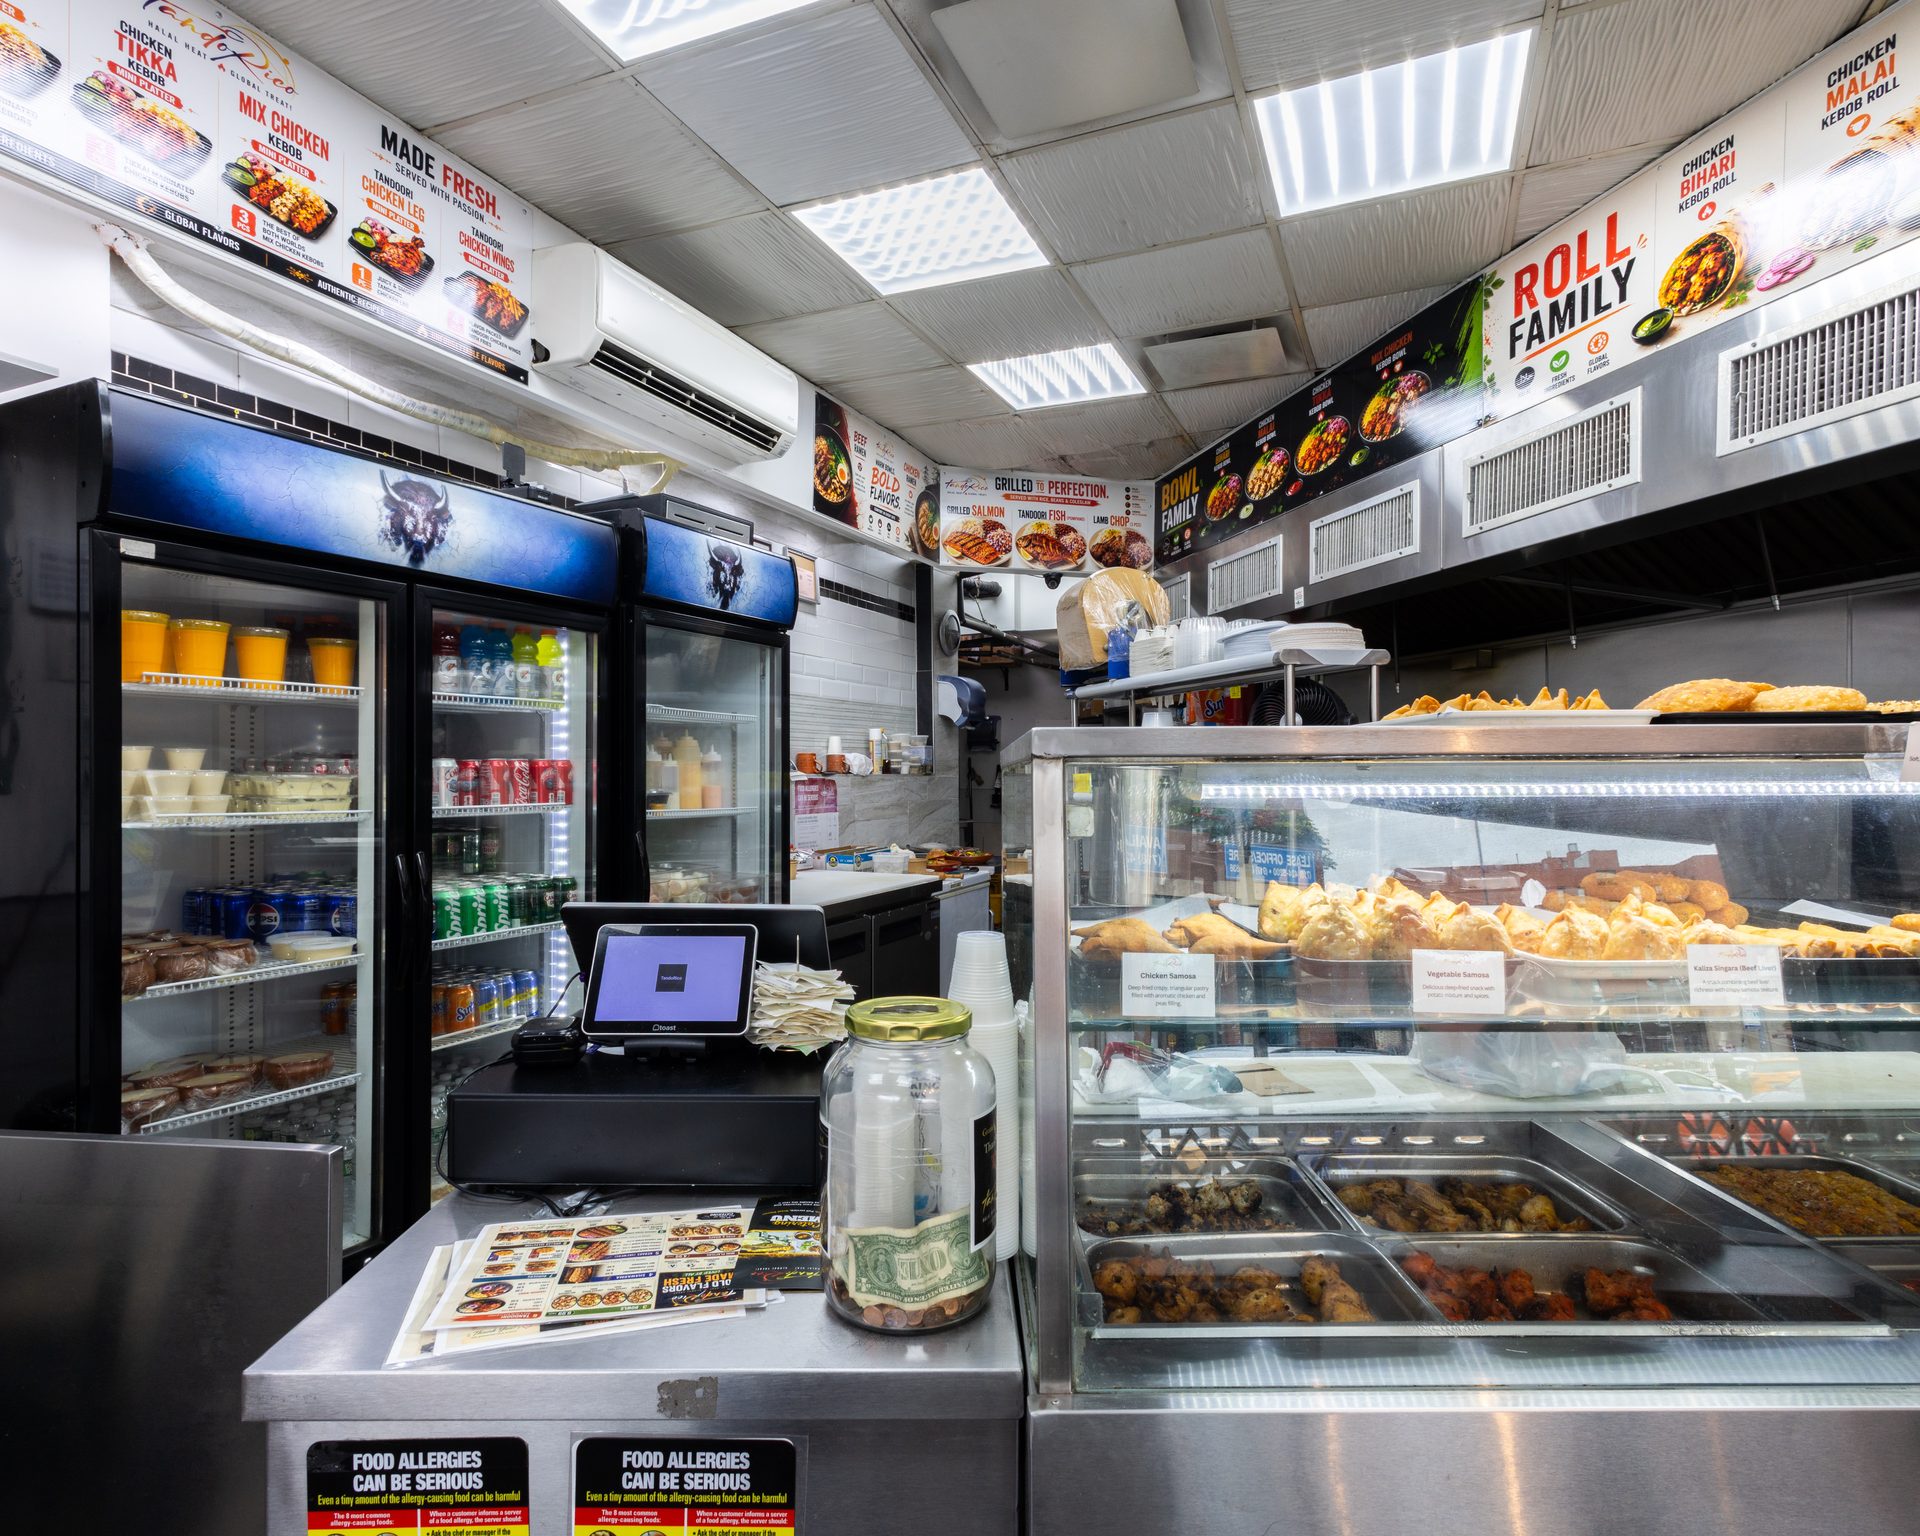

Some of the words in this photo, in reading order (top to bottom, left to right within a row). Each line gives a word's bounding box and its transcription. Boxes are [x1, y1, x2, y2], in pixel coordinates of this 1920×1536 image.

[119, 19, 173, 60] CHICKEN
[148, 20, 179, 44] HALAL
[184, 41, 207, 60] HEAT
[114, 29, 179, 84] TIKKA
[1827, 33, 1897, 88] CHICKEN
[116, 65, 138, 84] MINI
[139, 77, 177, 104] PLATTER
[128, 57, 166, 88] KEBOB
[1826, 53, 1896, 113] MALAI
[230, 69, 261, 93] GLOBAL
[265, 90, 293, 110] TREAT!
[1821, 98, 1863, 131] KEBOB
[1866, 77, 1900, 104] ROLL
[238, 91, 267, 127] MIX
[271, 109, 329, 162] CHICKEN
[268, 132, 303, 161] KEBOB
[1682, 134, 1734, 177] CHICKEN
[258, 144, 278, 161] MINI
[279, 154, 310, 178] PLATTER
[380, 125, 435, 180] MADE
[442, 163, 501, 221] FRESH.
[374, 168, 414, 200] TANDOORI
[1680, 150, 1736, 200] BIHARI
[362, 174, 405, 212] CHICKEN
[407, 197, 425, 223] LEG
[395, 162, 427, 189] SERVED
[429, 182, 450, 205] WITH
[452, 196, 487, 225] PASSION.
[1678, 187, 1710, 213] KEBOB
[1712, 172, 1737, 195] ROLL
[236, 221, 251, 233] PCS
[239, 208, 249, 223] 3
[372, 202, 390, 218] MINI
[391, 211, 415, 231] PLATTER
[165, 209, 199, 233] GLOBAL
[202, 226, 240, 252] FLAVORS
[262, 219, 275, 229] THE
[275, 225, 292, 237] BEST
[292, 234, 300, 242] OF
[262, 227, 280, 239] BOTH
[280, 236, 306, 252] WORLDS
[471, 226, 504, 252] TANDOORI
[262, 234, 274, 245] MIX
[274, 240, 301, 257] CHICKEN
[301, 253, 325, 268] KEBOBS
[459, 230, 490, 261] CHICKEN
[491, 248, 515, 274] WINGS
[358, 268, 365, 280] 1
[467, 253, 483, 268] MINI
[483, 262, 505, 282] PLATTER
[1513, 211, 1631, 319] ROLL
[317, 278, 356, 303] AUTHENTIC
[357, 295, 385, 316] RECIPES
[1509, 256, 1636, 360] FAMILY
[1371, 349, 1383, 366] MIX
[1384, 330, 1414, 358] CHICKEN
[1375, 356, 1392, 372] KEBOB
[1392, 346, 1407, 362] BOWL
[1588, 352, 1608, 367] GLOBAL
[481, 352, 508, 373] FLAVORS.
[1587, 359, 1610, 375] FLAVORS
[1312, 377, 1332, 396] CHICKEN
[1551, 371, 1567, 383] FRESH
[853, 430, 868, 447] BEEF
[854, 445, 867, 458] RAMEN
[871, 466, 901, 493] BOLD
[903, 462, 921, 480] CHICKEN
[906, 473, 917, 487] RAMEN
[869, 487, 902, 510] FLAVORS.
[994, 477, 1033, 493] GRILLED
[1036, 481, 1045, 491] TO
[1048, 480, 1109, 500] PERFECTION.
[1161, 465, 1200, 512] BOWL
[946, 505, 970, 515] GRILLED
[971, 505, 1005, 518] SALMON
[1018, 509, 1047, 520] TANDOORI
[1048, 509, 1066, 521] FISH
[1093, 515, 1109, 525] LAMB
[1109, 514, 1130, 527] CHOP
[1161, 493, 1199, 533] FAMILY
[248, 915, 278, 923] PPSI
[1169, 972, 1197, 980] Samosa
[1427, 970, 1461, 978] Vegetable
[659, 1023, 677, 1031] toast
[662, 1282, 709, 1293] FLAVORS
[663, 1275, 702, 1286] FRESH
[712, 1278, 732, 1288] OLD
[352, 1453, 395, 1471] FOOD
[398, 1451, 482, 1469] ALLERGIES
[622, 1451, 663, 1469] FOOD
[667, 1452, 750, 1469] ALLERGIES
[353, 1474, 387, 1492] CAN
[391, 1474, 412, 1491] BE
[415, 1472, 483, 1490] SERIOUS
[622, 1472, 656, 1490] CAN
[659, 1472, 680, 1490] BE
[683, 1473, 751, 1490] SERIOUS
[317, 1494, 335, 1506] Even
[335, 1496, 340, 1505] a
[340, 1494, 354, 1507] tiny
[354, 1494, 381, 1505] amount
[382, 1494, 389, 1504] of
[389, 1493, 400, 1504] the
[401, 1492, 454, 1506] allergy-causing
[454, 1491, 470, 1502] food
[470, 1492, 485, 1502] can
[485, 1491, 494, 1501] be
[495, 1490, 521, 1501] harmful
[330, 1519, 375, 1527] allergy-causing
[454, 1516, 474, 1524] allergy,
